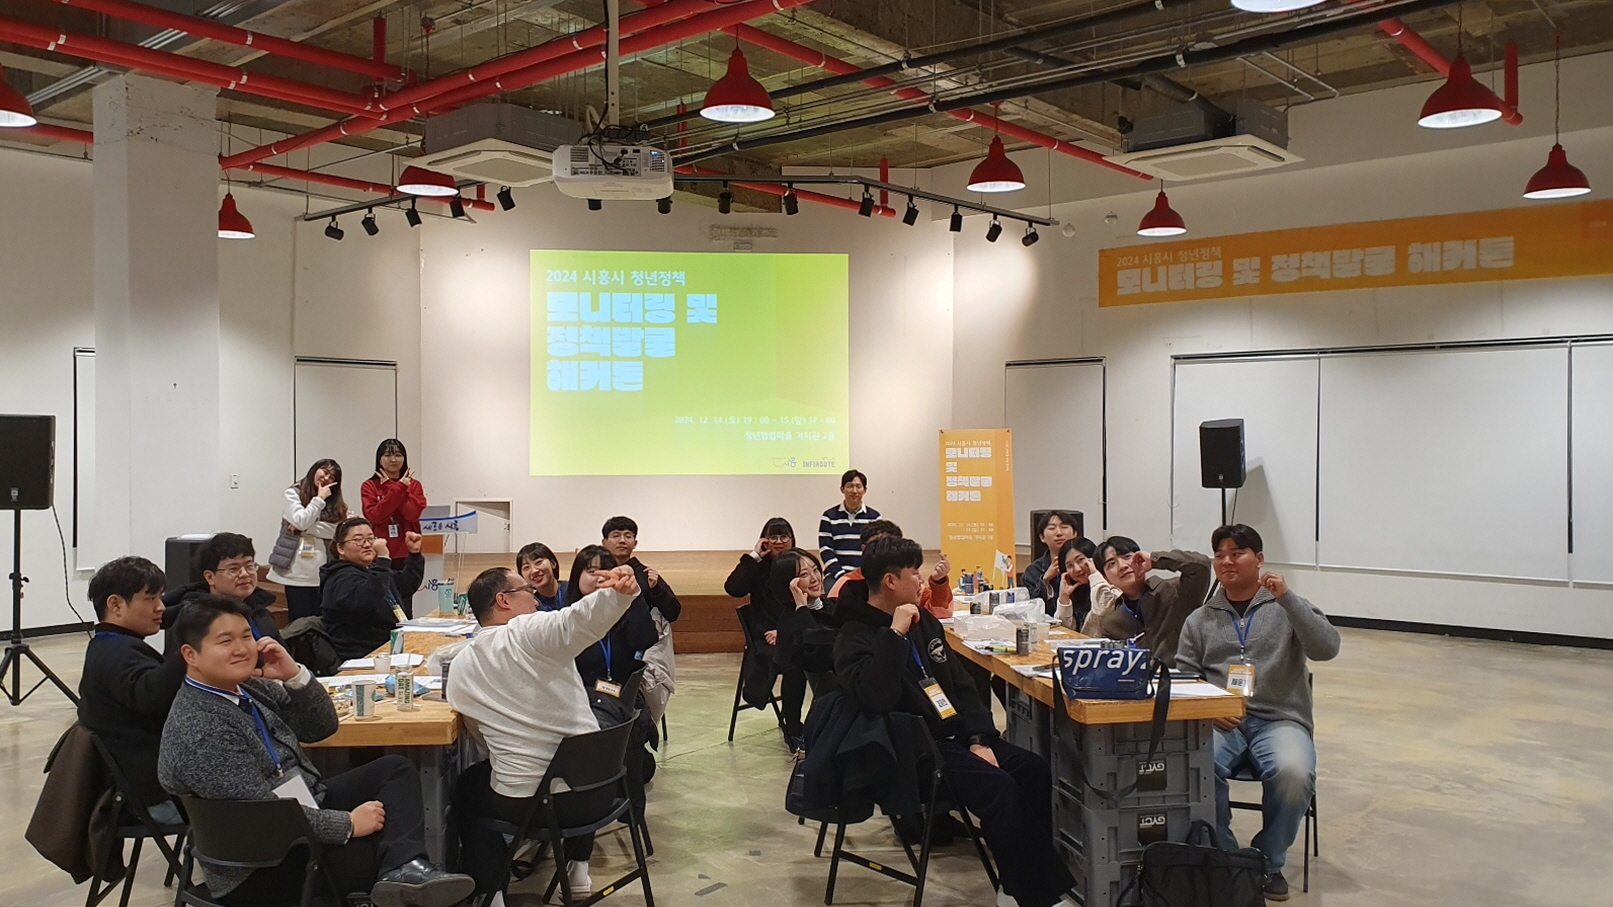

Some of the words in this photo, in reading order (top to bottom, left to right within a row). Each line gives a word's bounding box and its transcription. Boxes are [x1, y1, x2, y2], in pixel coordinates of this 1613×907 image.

[1117, 255, 1139, 267] 2024
[1142, 253, 1173, 265] 시흥시
[1178, 246, 1221, 262] 청년정책
[546, 269, 577, 283] 2024
[583, 269, 624, 285] 시흥시
[631, 270, 686, 286] 청년정책
[1117, 260, 1223, 296] 모니터링
[1232, 256, 1261, 286] 및
[546, 292, 676, 323] 모니터링
[686, 293, 718, 324] 및
[546, 360, 643, 391] 해커톤
[1063, 649, 1147, 676] spray
